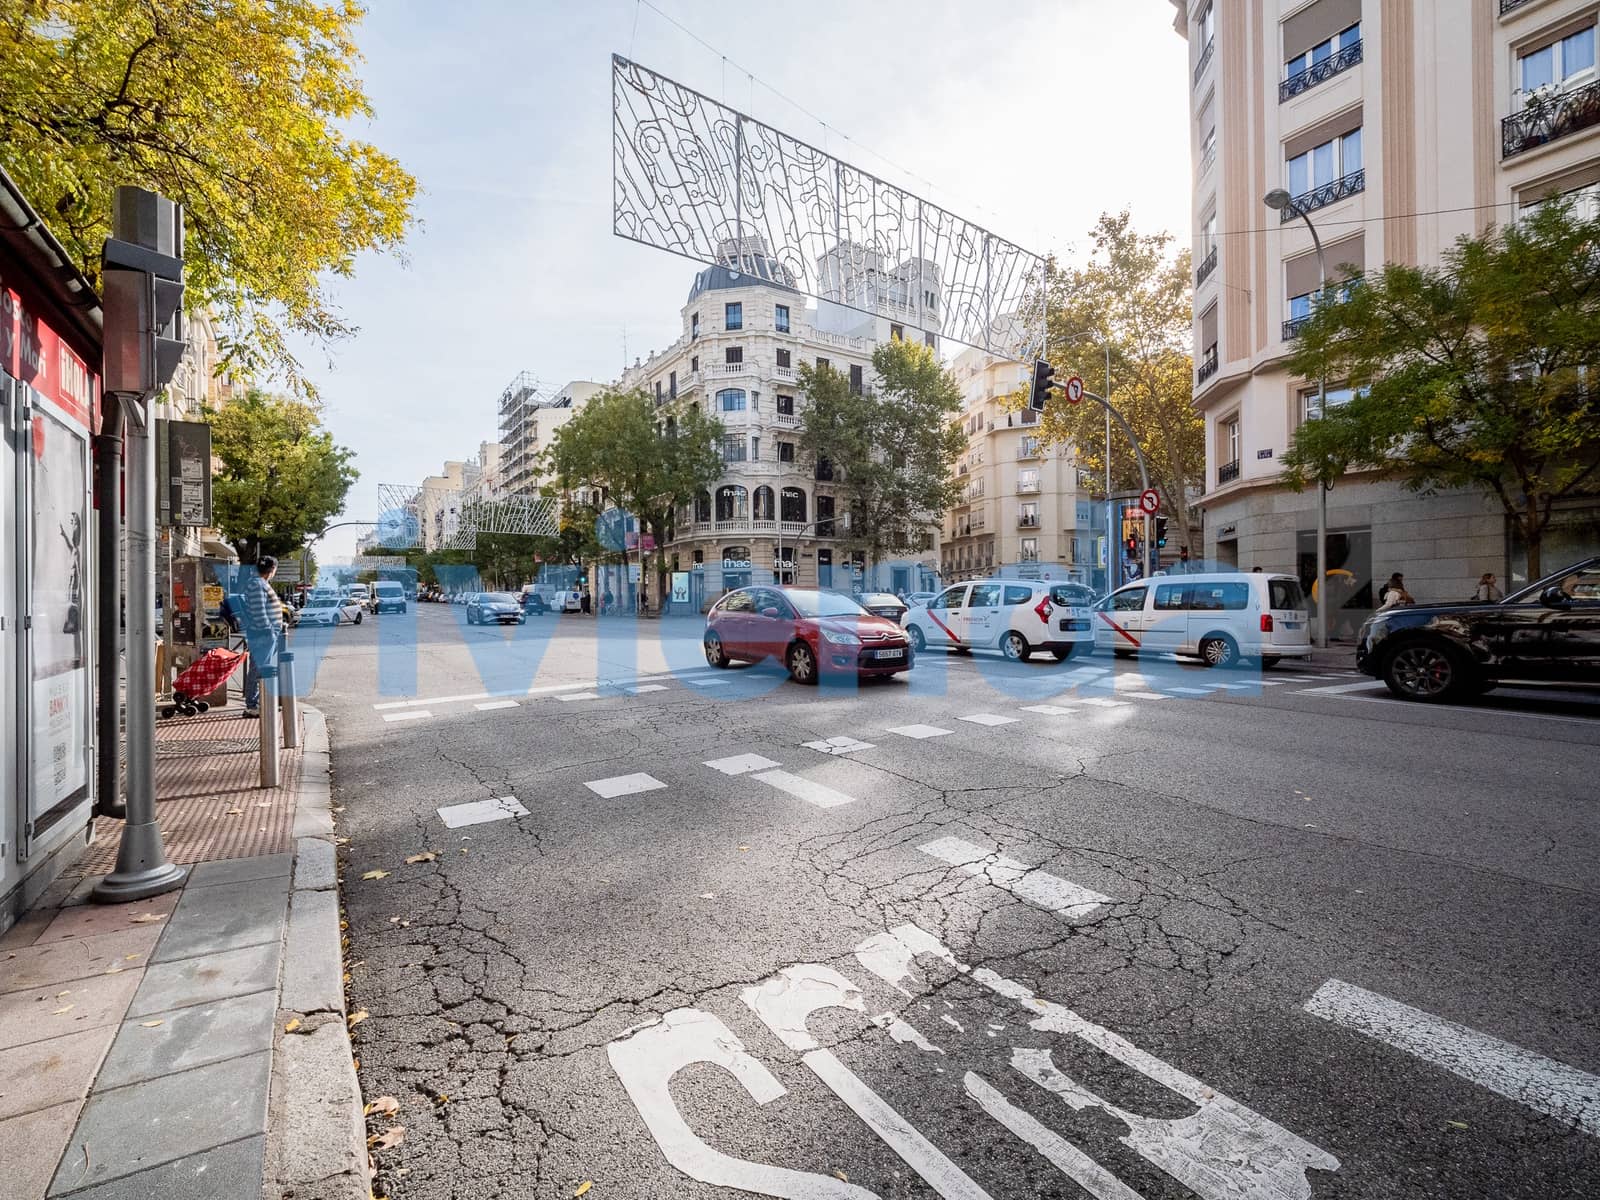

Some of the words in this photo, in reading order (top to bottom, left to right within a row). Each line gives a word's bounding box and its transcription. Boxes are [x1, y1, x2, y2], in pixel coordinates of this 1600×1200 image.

[20, 331, 47, 378] Mari
[723, 488, 747, 497] fnac
[780, 489, 799, 498] nac
[723, 558, 751, 568] fnac
